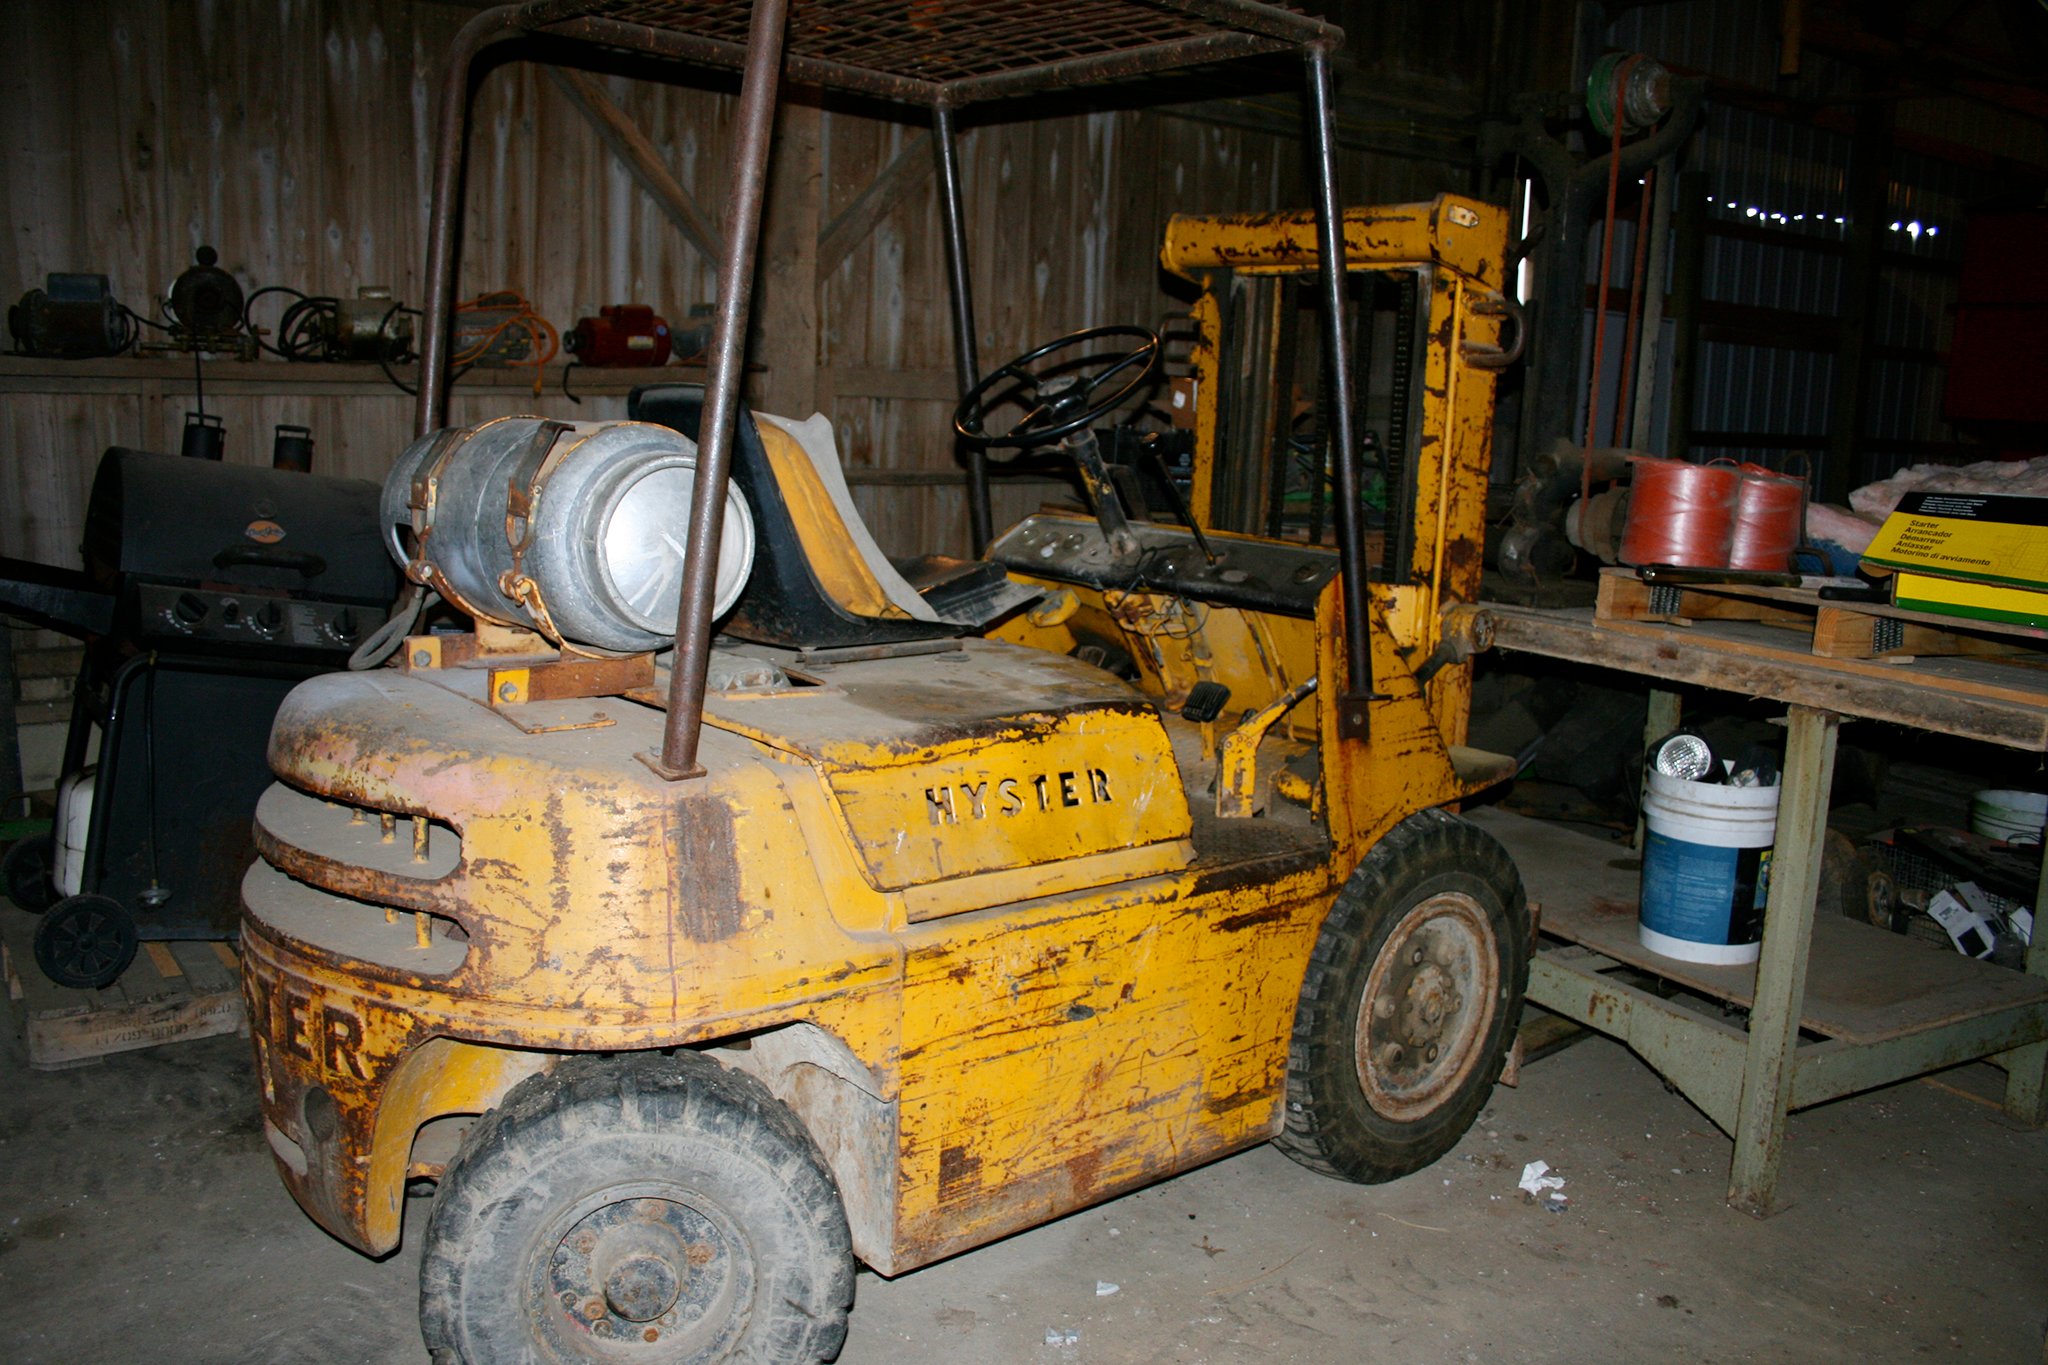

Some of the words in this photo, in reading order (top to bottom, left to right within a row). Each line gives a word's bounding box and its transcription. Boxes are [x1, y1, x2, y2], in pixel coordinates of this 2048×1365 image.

[1910, 519, 1939, 529] Starter
[1905, 527, 1952, 538] Arrancador
[1896, 540, 1933, 551] Anlasser
[1891, 547, 1929, 559] Motorino
[1930, 551, 1939, 560] di
[1940, 554, 1991, 567] avviamento
[925, 768, 1113, 826] HYSTER
